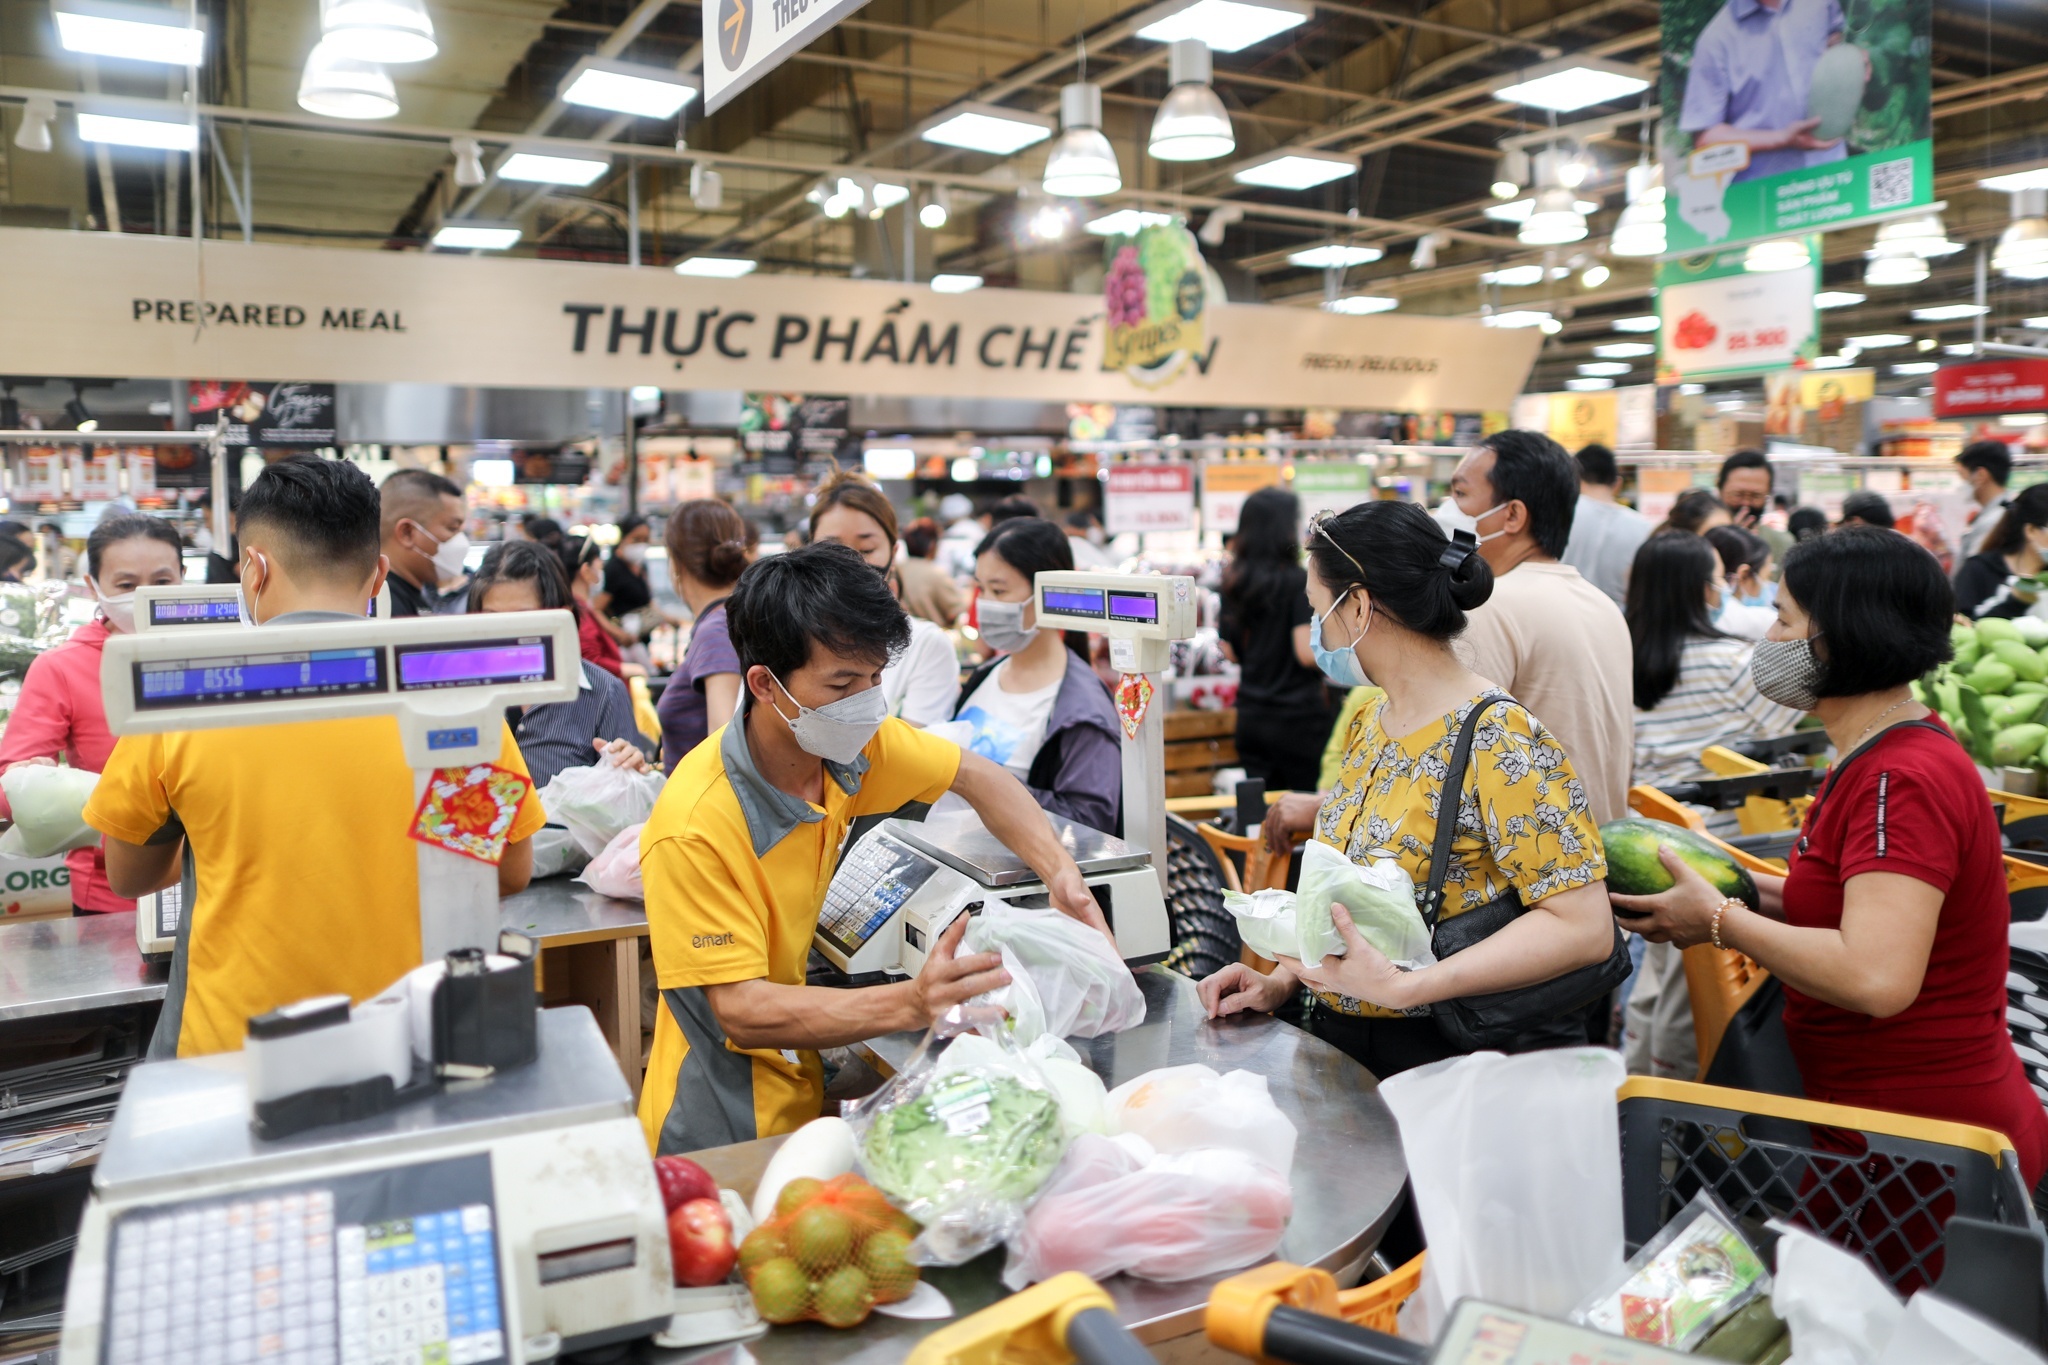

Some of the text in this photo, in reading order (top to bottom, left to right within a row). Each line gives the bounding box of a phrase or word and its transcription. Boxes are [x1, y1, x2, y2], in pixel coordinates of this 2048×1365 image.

[132, 298, 407, 333] PREPARED MEAL
[563, 303, 755, 370] THỰC
[770, 299, 961, 367] PHẨM
[519, 674, 544, 683] CAS
[433, 733, 472, 745] CAS
[692, 932, 735, 949] emart
